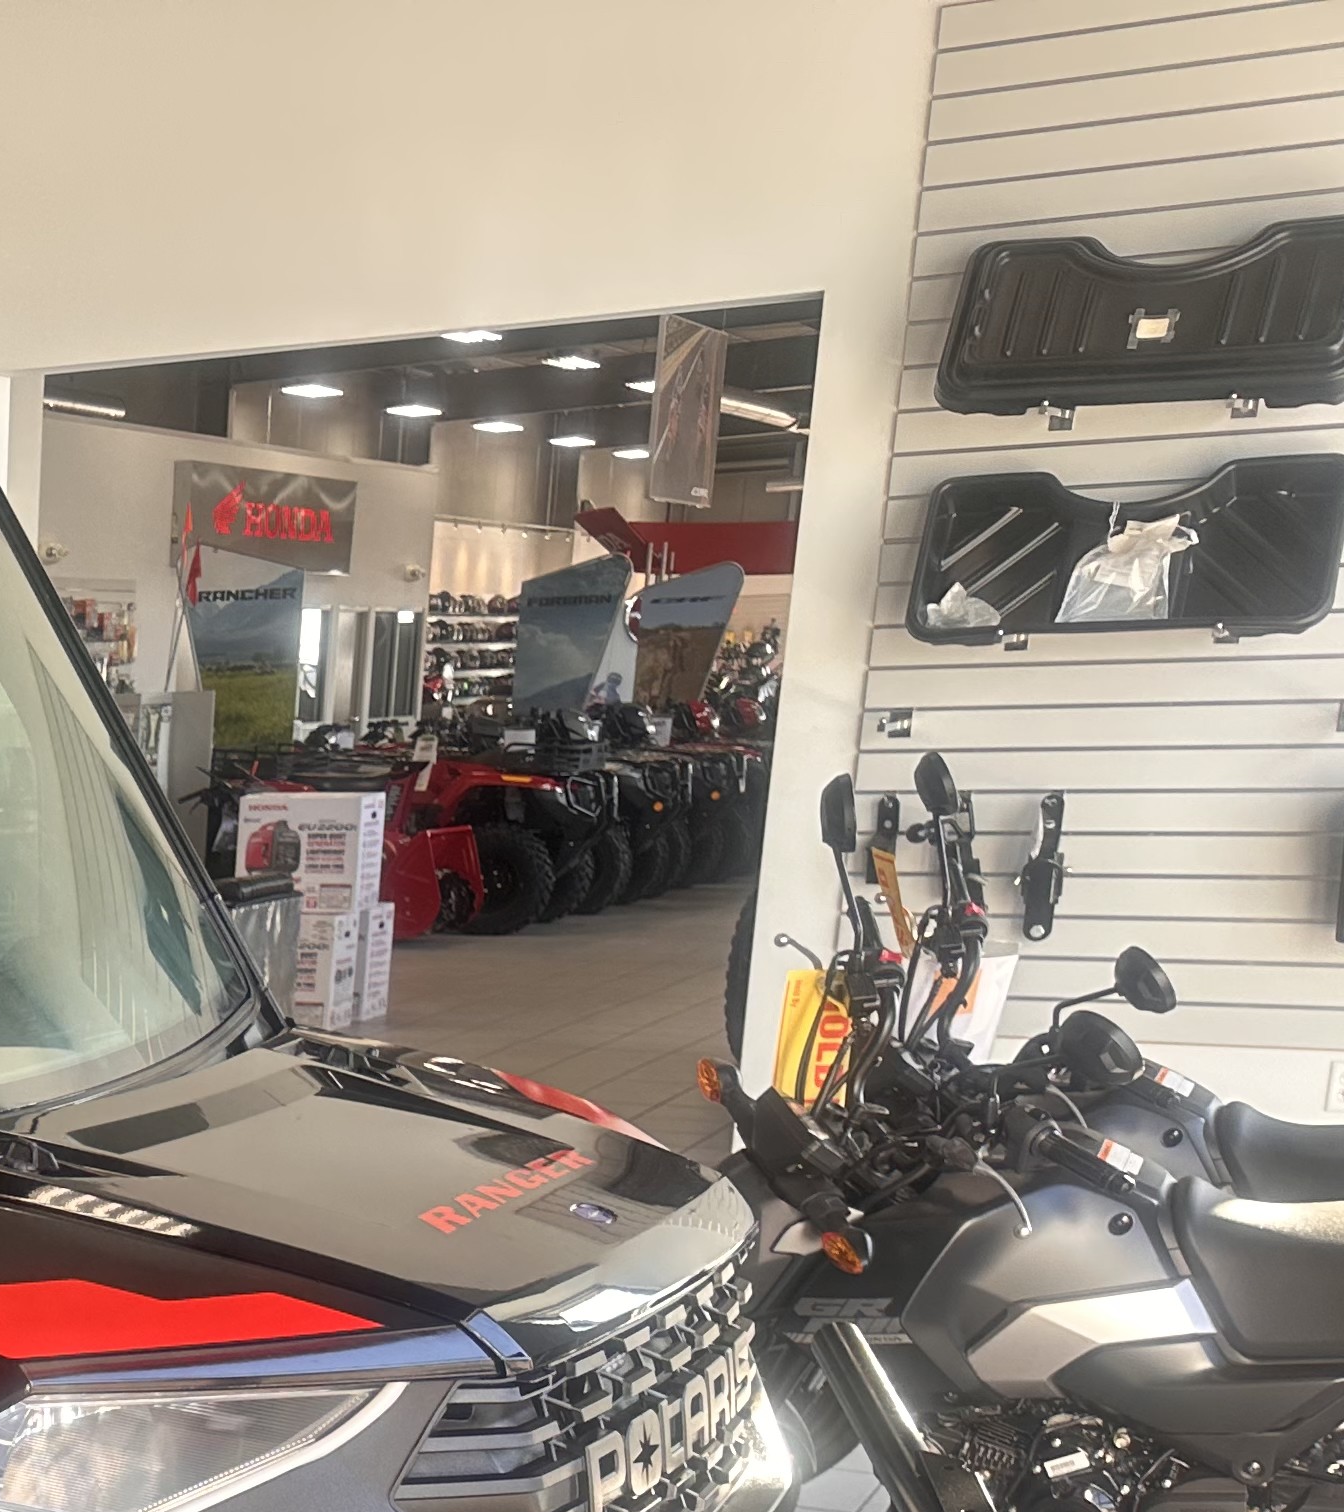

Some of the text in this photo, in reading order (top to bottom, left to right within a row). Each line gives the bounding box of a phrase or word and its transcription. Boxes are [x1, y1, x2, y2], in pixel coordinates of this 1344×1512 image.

[242, 501, 335, 544] HONDA
[198, 587, 297, 603] RANCHER
[417, 1148, 595, 1237] RANGER
